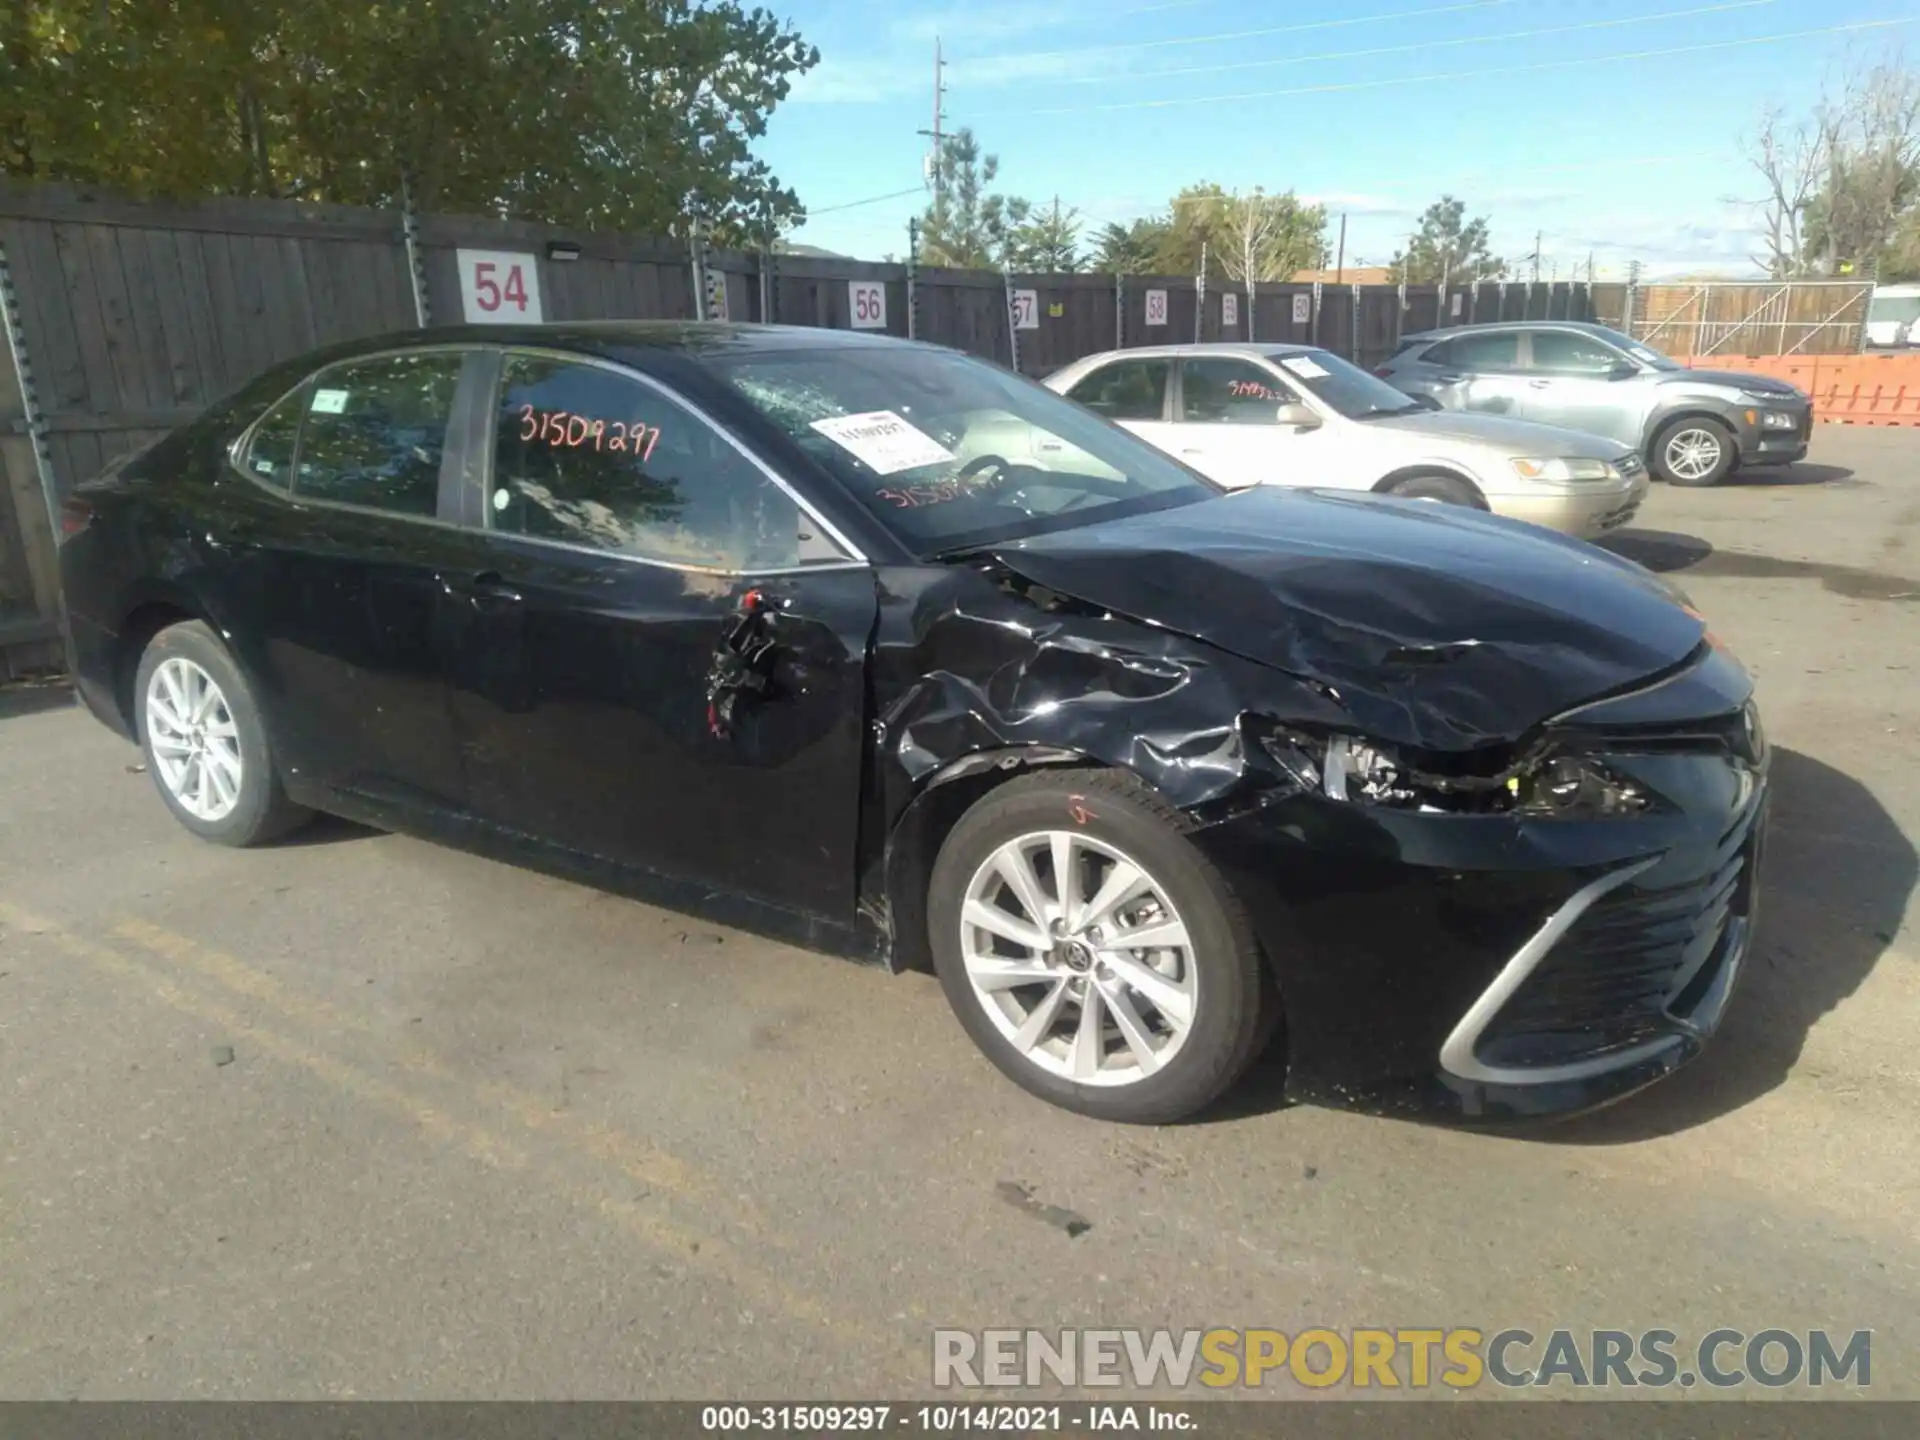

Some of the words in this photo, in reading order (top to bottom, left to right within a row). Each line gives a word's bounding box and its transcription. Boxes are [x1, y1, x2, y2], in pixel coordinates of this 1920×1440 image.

[475, 262, 529, 312] 54
[856, 289, 881, 320] 56
[1013, 295, 1032, 326] 57
[1149, 296, 1165, 319] 58
[519, 404, 661, 463] 31509297
